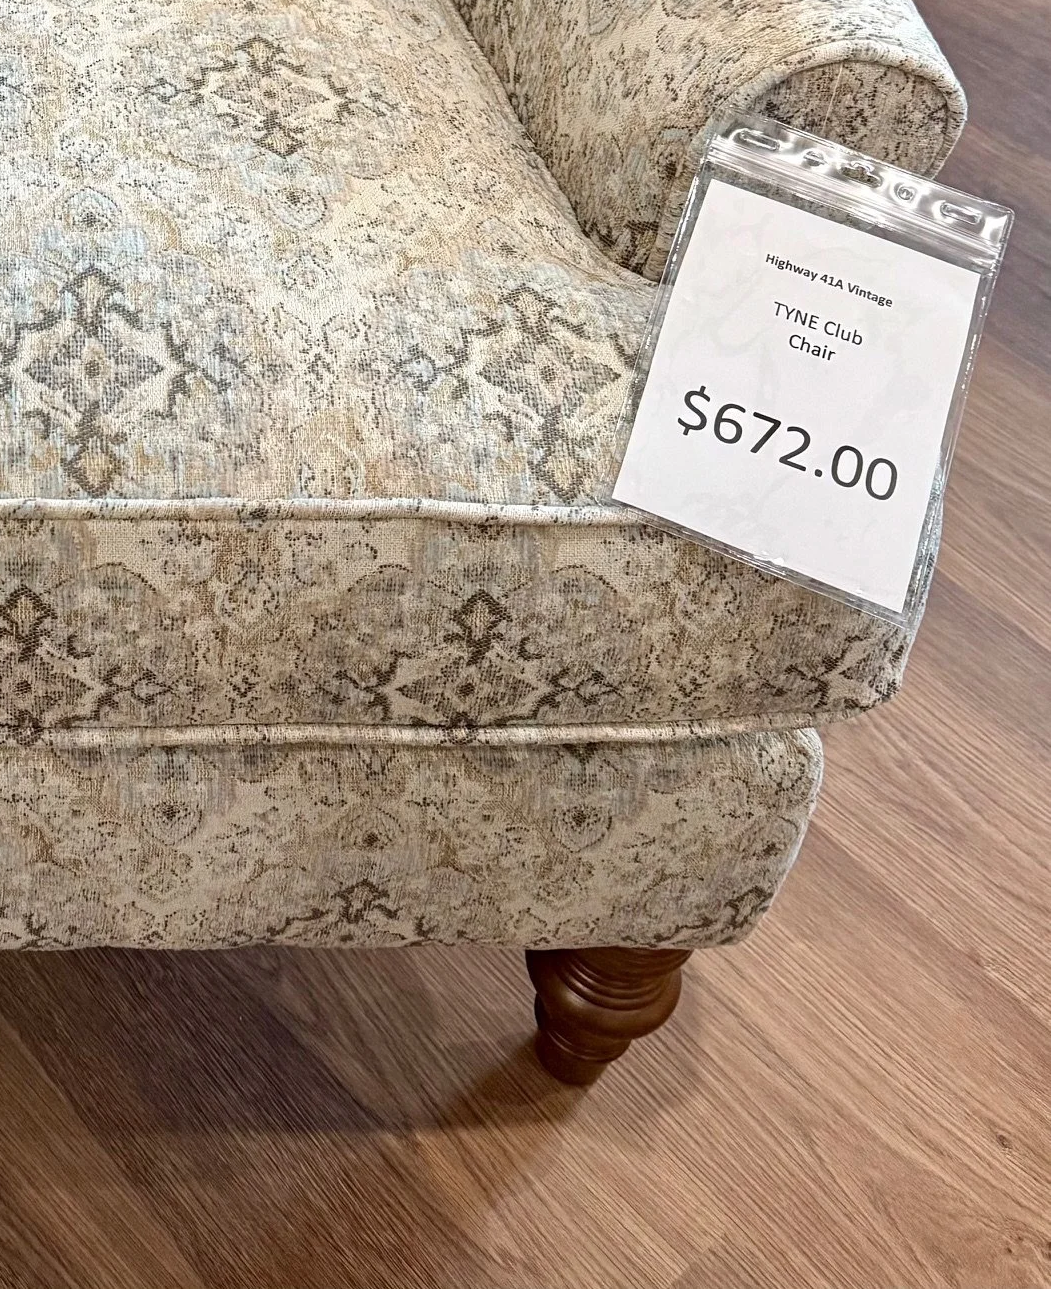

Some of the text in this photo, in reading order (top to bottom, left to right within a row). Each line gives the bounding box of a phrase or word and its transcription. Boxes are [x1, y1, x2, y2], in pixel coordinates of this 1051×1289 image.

[765, 253, 893, 308] Highway 41A Vintage
[774, 301, 863, 346] TYNE Club
[788, 334, 837, 361] Chair
[677, 385, 899, 501] $672.00
